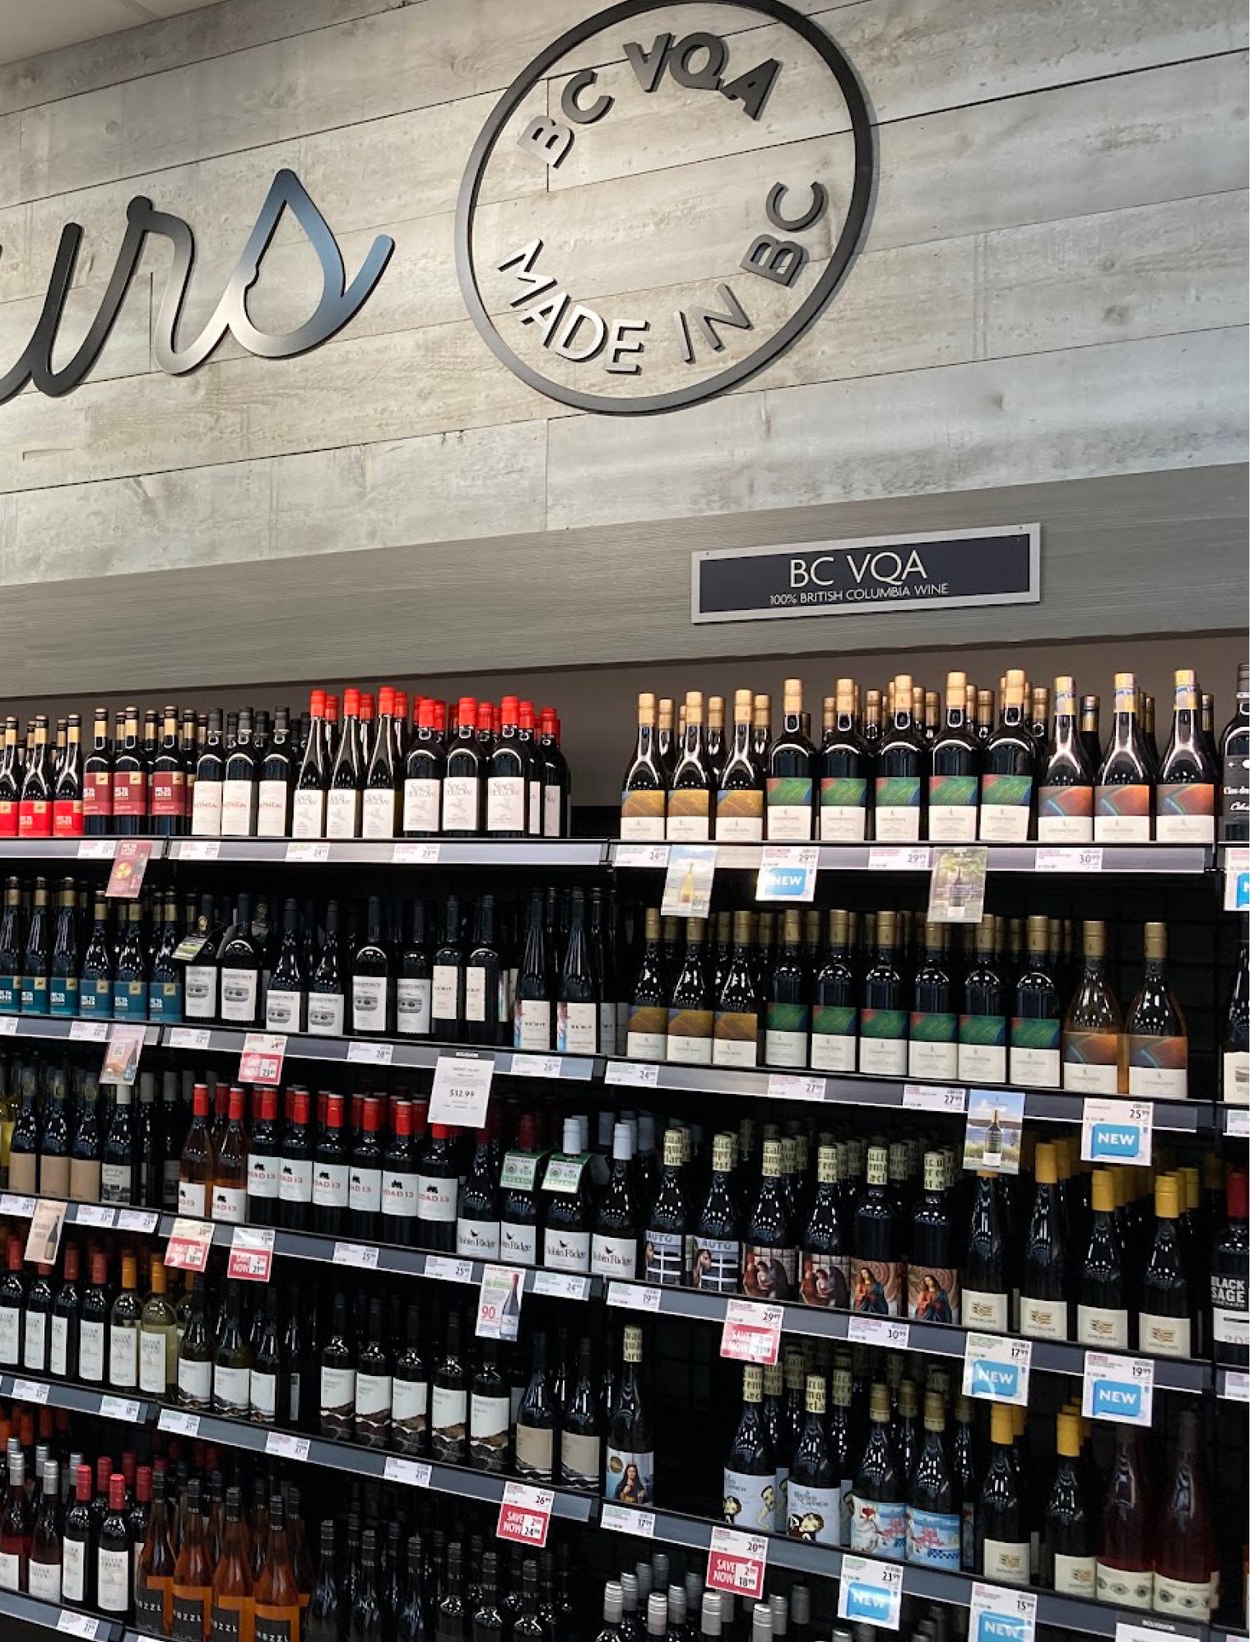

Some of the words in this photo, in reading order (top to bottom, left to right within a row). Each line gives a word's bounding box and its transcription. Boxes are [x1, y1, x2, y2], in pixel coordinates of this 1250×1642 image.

[517, 69, 612, 167] BC
[623, 31, 783, 120] VQA
[497, 239, 650, 374] MADE
[673, 283, 750, 363] IN
[741, 181, 827, 286] BC
[790, 556, 834, 588] BC
[846, 549, 928, 586] VQA
[770, 594, 797, 605] 100%
[800, 590, 843, 604] BRITISH
[846, 586, 911, 601] COLUMBIA
[915, 583, 949, 596] WINE
[772, 875, 802, 886] NEW
[1098, 1132, 1134, 1146] NEW
[1211, 1286, 1246, 1303] SAGE
[482, 1305, 496, 1320] 90
[978, 1371, 1013, 1386] NEW
[1100, 1391, 1137, 1406] NEW
[507, 1511, 525, 1523] SAVE
[504, 1521, 522, 1535] NOW
[716, 1559, 736, 1573] SAVE
[713, 1570, 735, 1584] NOW
[853, 1591, 887, 1609] NEW
[985, 1622, 1021, 1639] NEW
